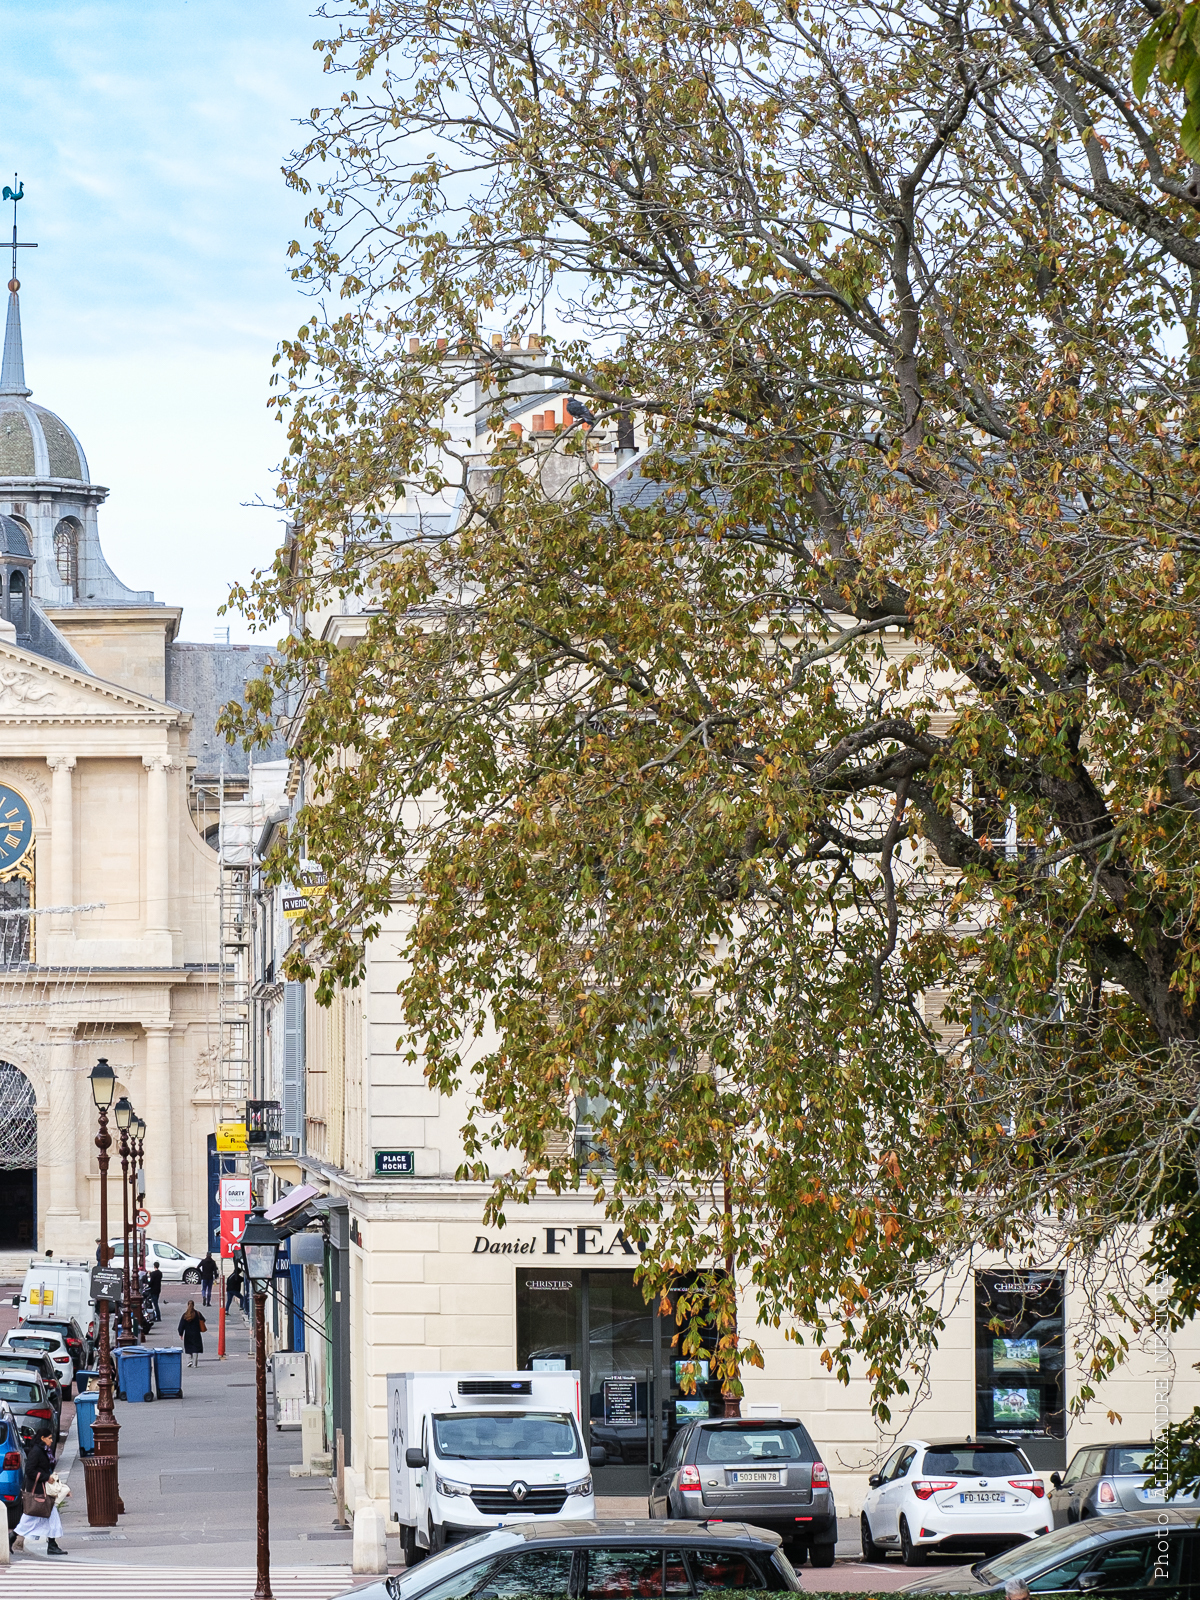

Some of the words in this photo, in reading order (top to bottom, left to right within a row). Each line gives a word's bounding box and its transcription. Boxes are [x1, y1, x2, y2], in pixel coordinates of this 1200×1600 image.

[290, 899, 309, 908] VEND
[471, 1236, 537, 1254] Daniel
[525, 1280, 573, 1288] CHRISTIE'S
[739, 1472, 753, 1481] 503
[754, 1472, 767, 1481] EHN
[768, 1471, 777, 1480] 78
